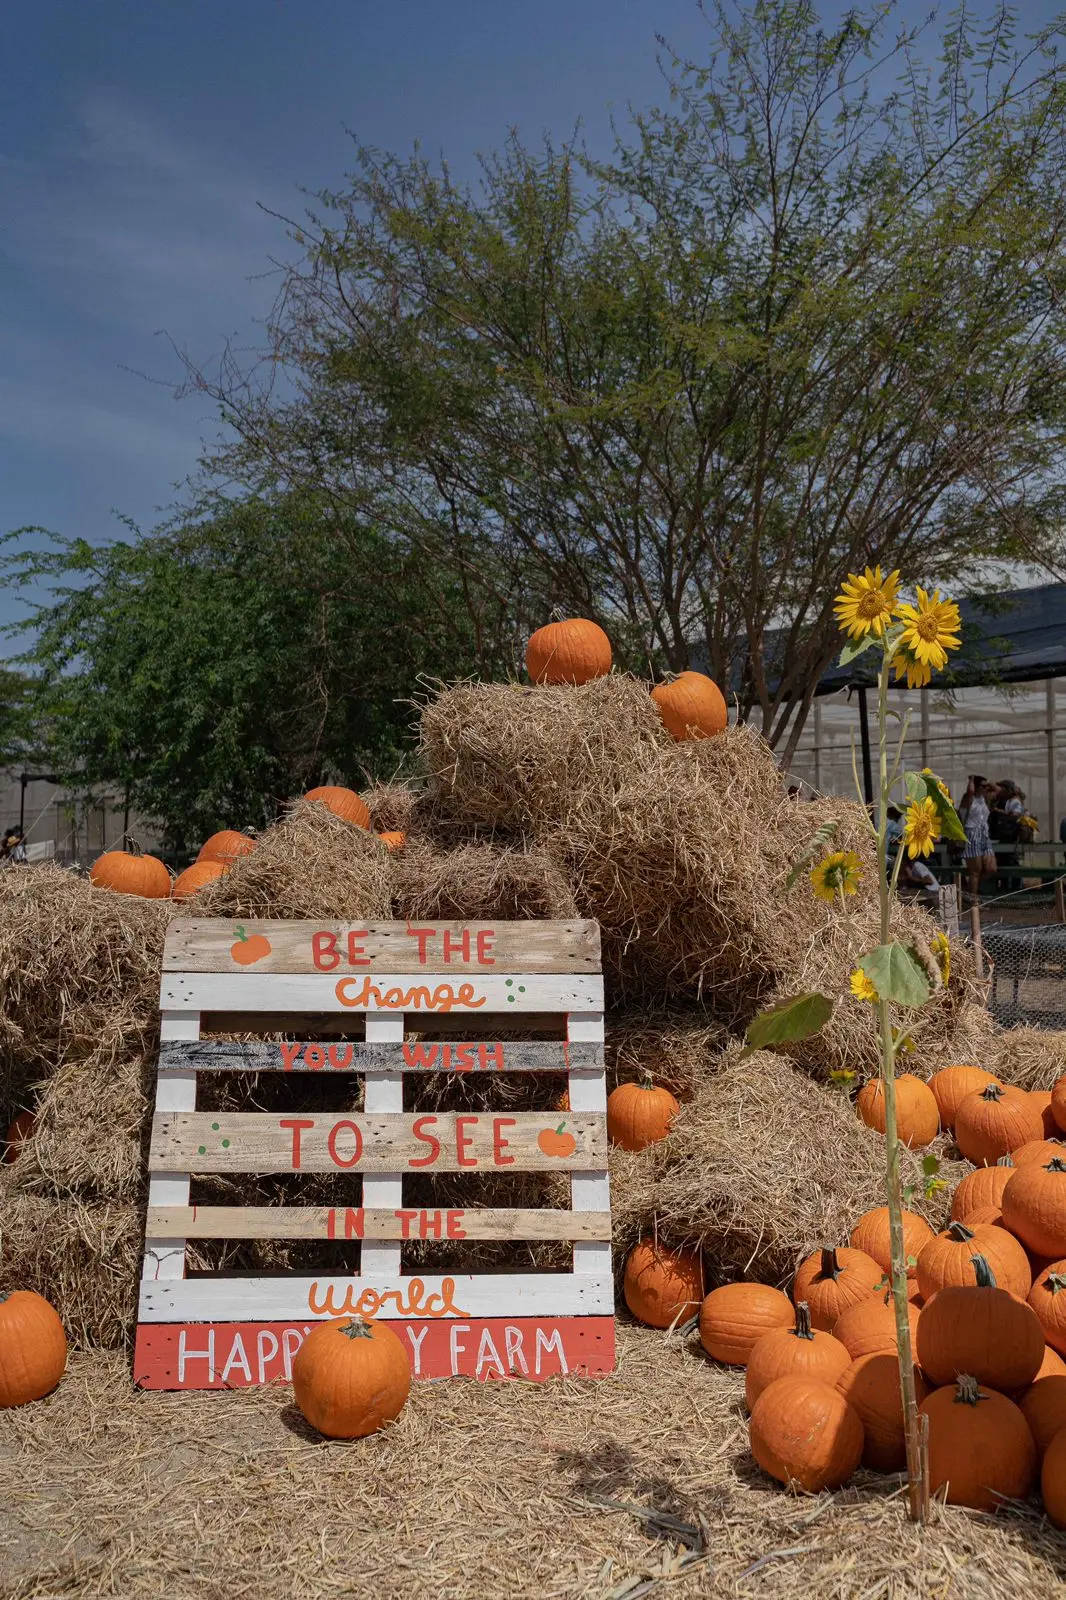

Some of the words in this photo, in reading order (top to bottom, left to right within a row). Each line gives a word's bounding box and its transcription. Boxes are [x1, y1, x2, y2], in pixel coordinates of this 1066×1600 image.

[312, 930, 371, 971] BE
[406, 928, 496, 964] THE
[335, 976, 487, 1012] Change
[279, 1043, 353, 1071] YOU
[402, 1042, 504, 1071] WISH
[279, 1119, 363, 1168] TO
[408, 1116, 516, 1167] SEE
[327, 1208, 365, 1239] IN
[394, 1209, 467, 1239] THE
[178, 1327, 311, 1383] HAPP
[450, 1325, 569, 1375] FARM
